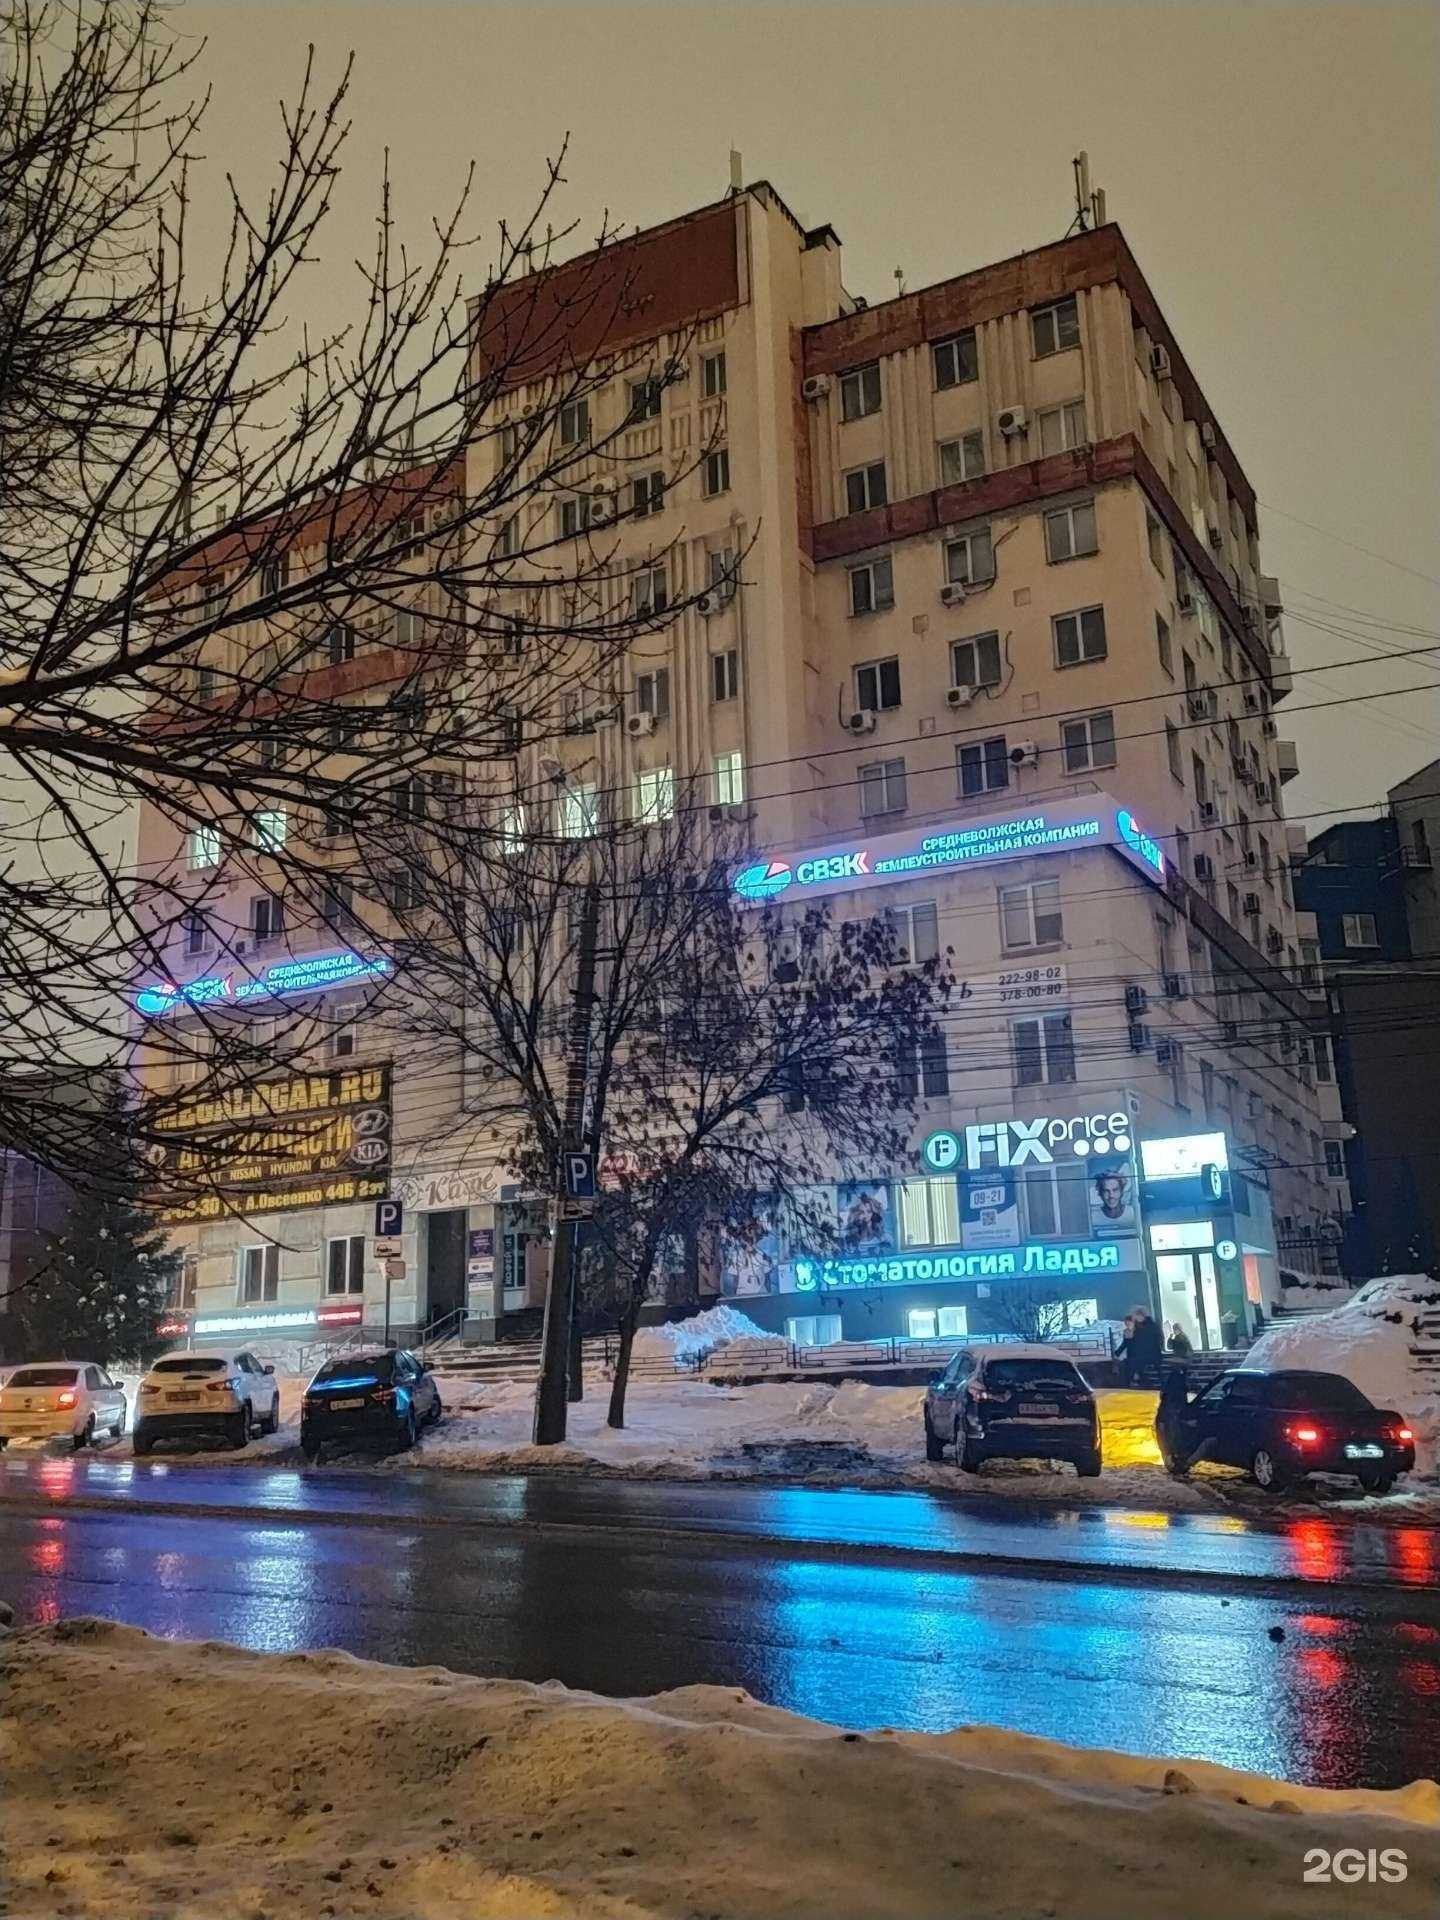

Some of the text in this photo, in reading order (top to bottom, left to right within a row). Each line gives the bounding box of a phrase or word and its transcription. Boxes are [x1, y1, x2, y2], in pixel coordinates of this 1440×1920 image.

[875, 821, 1099, 873] ЗЕМЛЕУСТРОИТЕЛЬНАЯ КОМПАНИЯ
[922, 817, 1045, 851] СРЕДНЕВОЛЖСКАЯ
[797, 853, 864, 884] СВЗК
[230, 1166, 262, 1181] NISSAN
[270, 1160, 312, 1175] HYUNDAI
[320, 1156, 337, 1170] KIA
[570, 1157, 587, 1192] P
[326, 1183, 354, 1199] 44Б
[380, 1204, 397, 1233] P
[823, 1246, 1119, 1285] Стоматология Ладья
